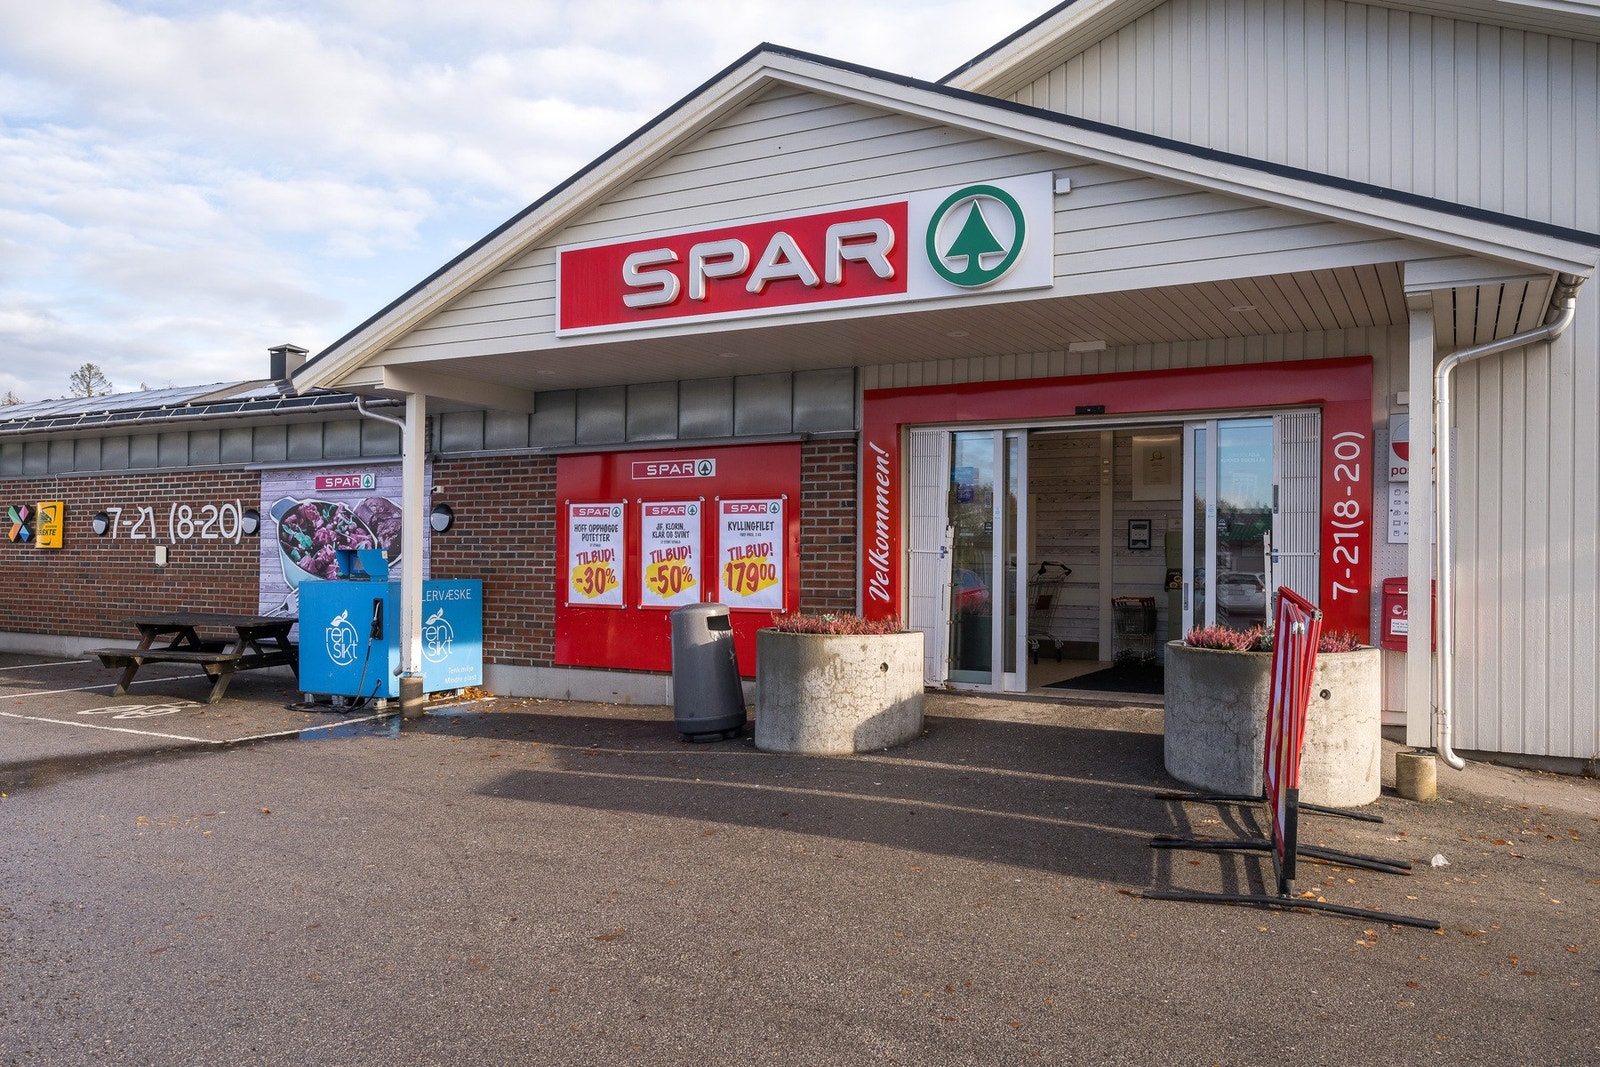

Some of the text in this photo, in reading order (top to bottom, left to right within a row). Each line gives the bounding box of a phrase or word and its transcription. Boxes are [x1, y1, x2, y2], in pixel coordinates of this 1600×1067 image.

[622, 218, 895, 308] SPAR
[646, 463, 693, 475] SPAR
[325, 477, 360, 487] SPAR
[578, 508, 610, 516] SPAR
[652, 506, 685, 515] SPAR
[731, 504, 767, 513] SPAR
[106, 499, 242, 545] 7-21 (8-20)
[727, 521, 774, 532] KYLLINGFILET
[868, 440, 891, 601] Velkommen!
[574, 524, 587, 533] HOFF
[652, 530, 665, 539] KLAR
[666, 530, 673, 539] OG
[581, 533, 611, 542] POTETTER
[576, 548, 615, 566] TILBUD!
[649, 545, 692, 565] TILBUD!
[727, 542, 773, 562] TILBUD!
[576, 566, 616, 595] -30%
[650, 565, 693, 594] -50%
[421, 588, 472, 601] ERVÆSKE
[325, 627, 352, 643] ren
